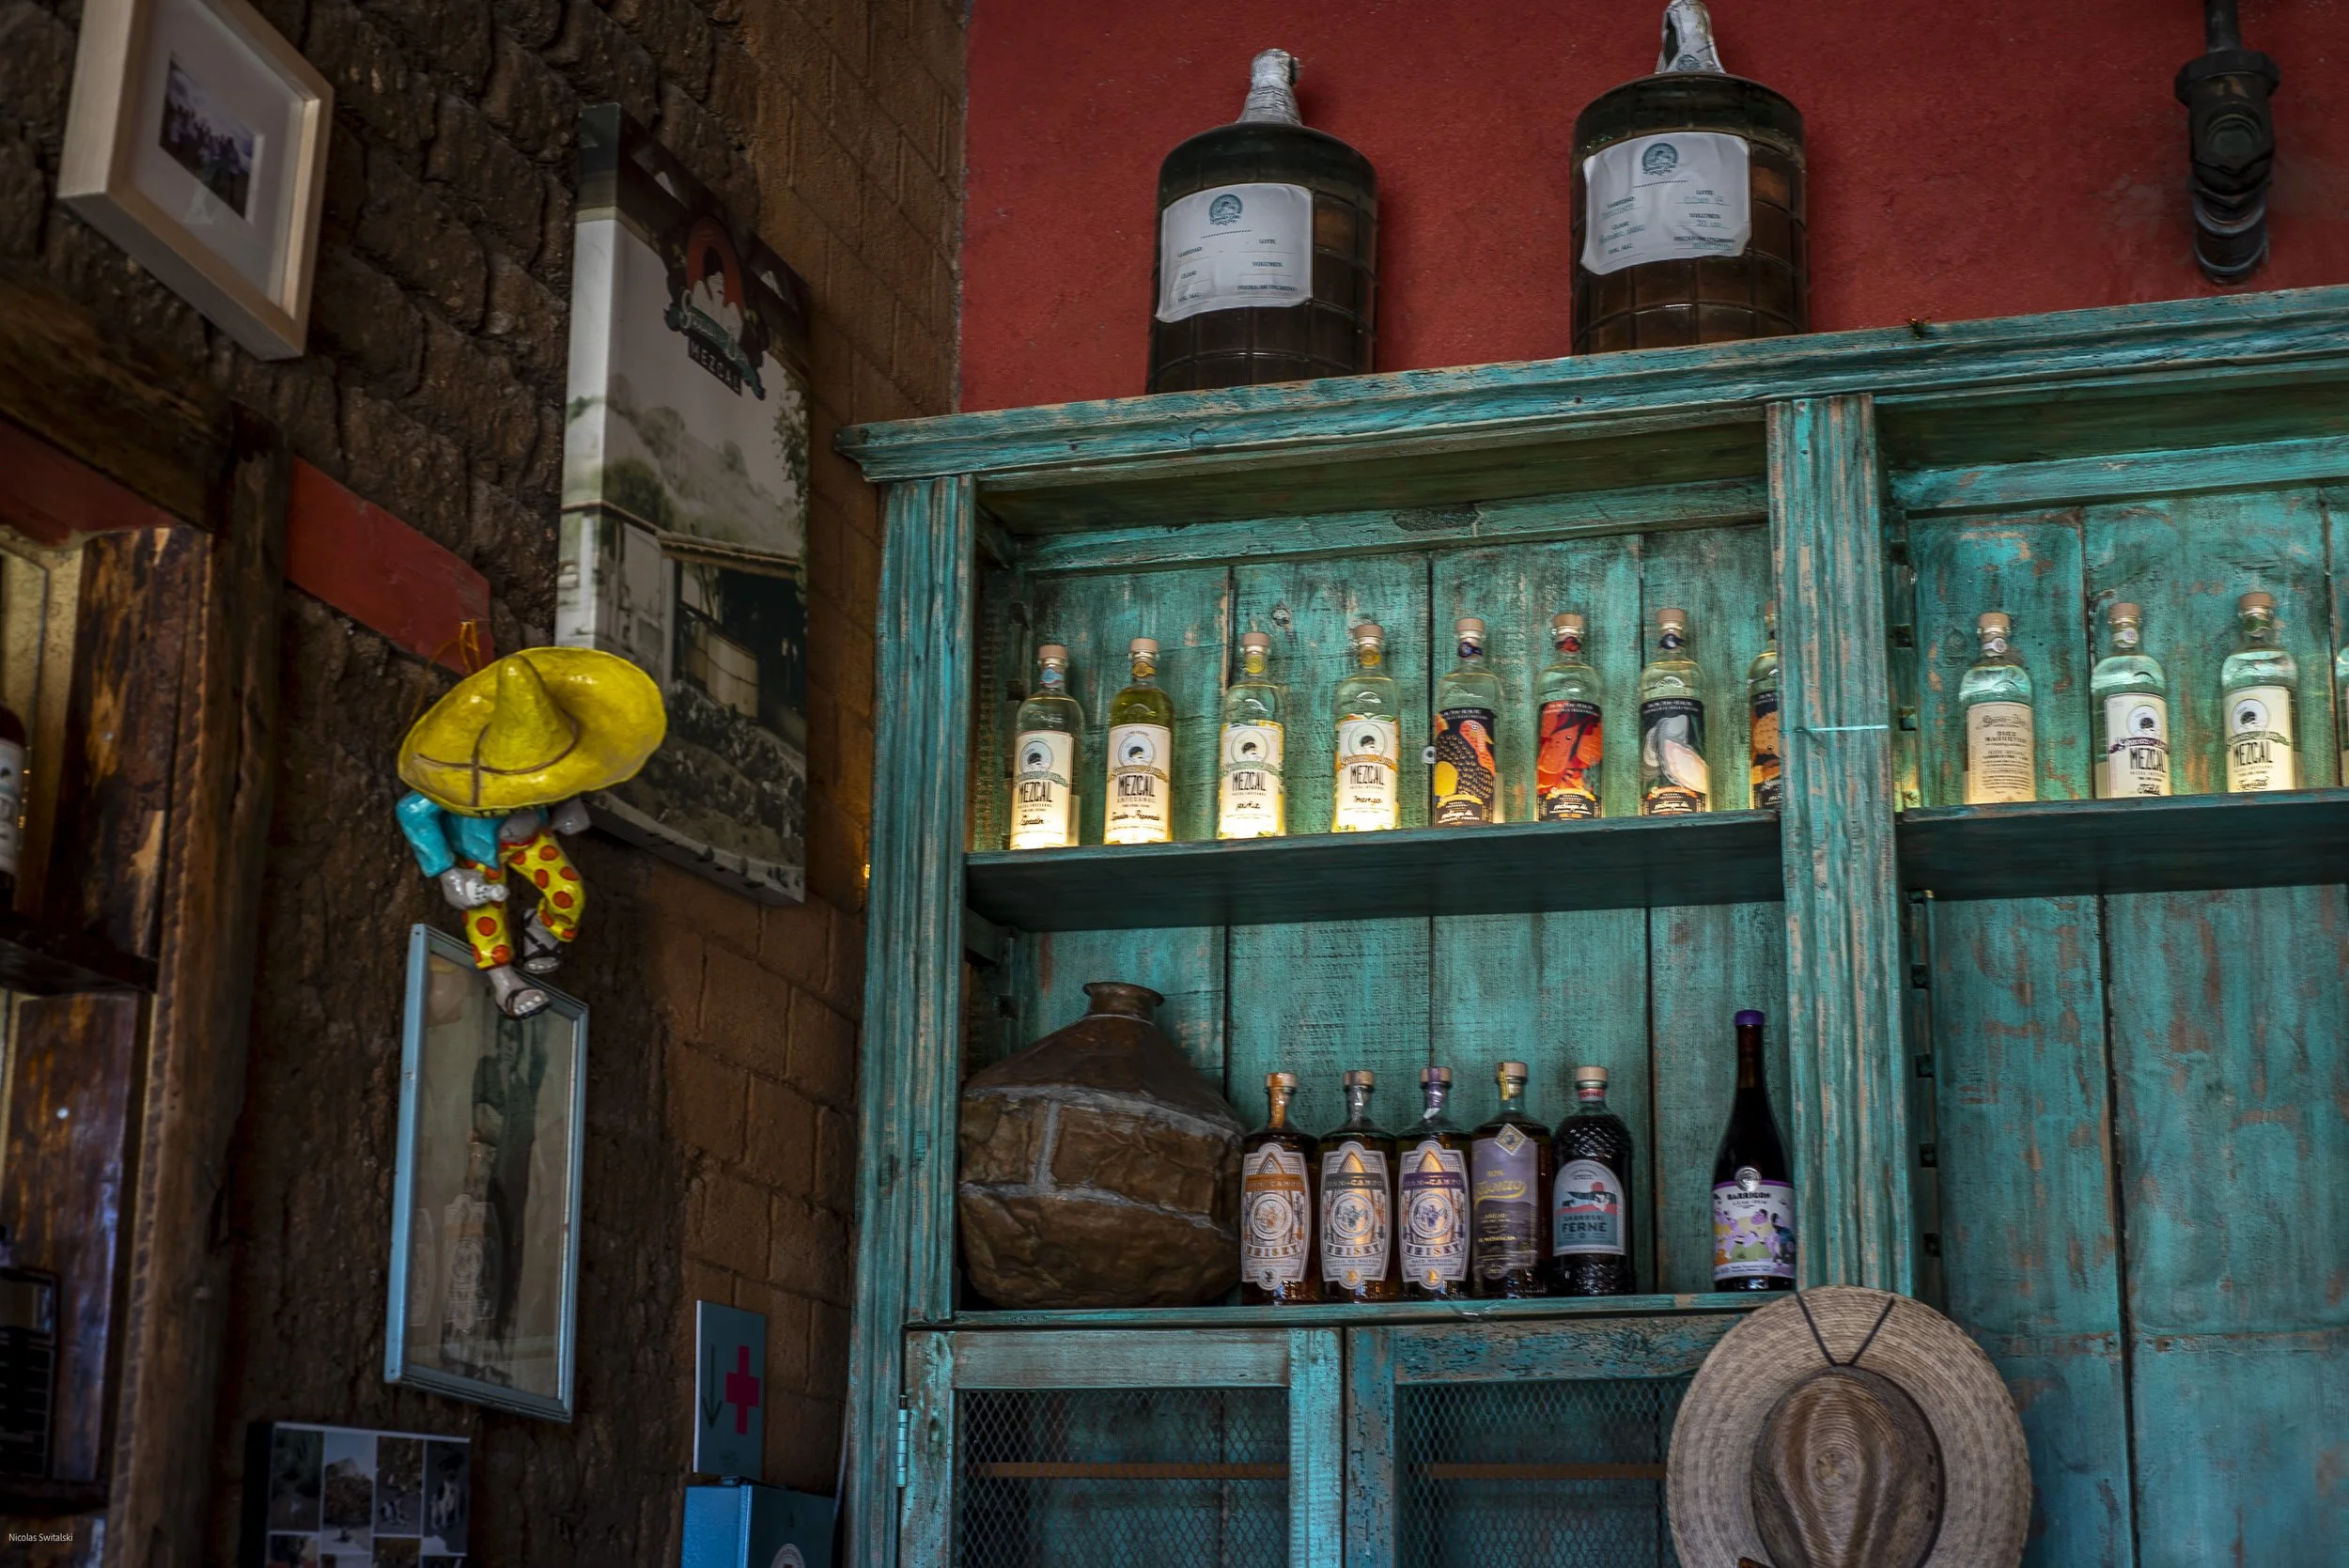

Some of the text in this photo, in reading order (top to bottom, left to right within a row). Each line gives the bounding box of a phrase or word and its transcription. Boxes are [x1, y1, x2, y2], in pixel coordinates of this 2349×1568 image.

[691, 339, 741, 393] MEZCAL
[2129, 747, 2167, 773] MEZCAL
[2232, 740, 2274, 768] MEZCAL
[1232, 771, 1267, 792] MEZCAL
[1350, 765, 1385, 785] MEZCAL
[1018, 782, 1053, 803] MEZCAL
[1117, 775, 1156, 798] MEZCAL
[1562, 1222, 1608, 1234] FERNE
